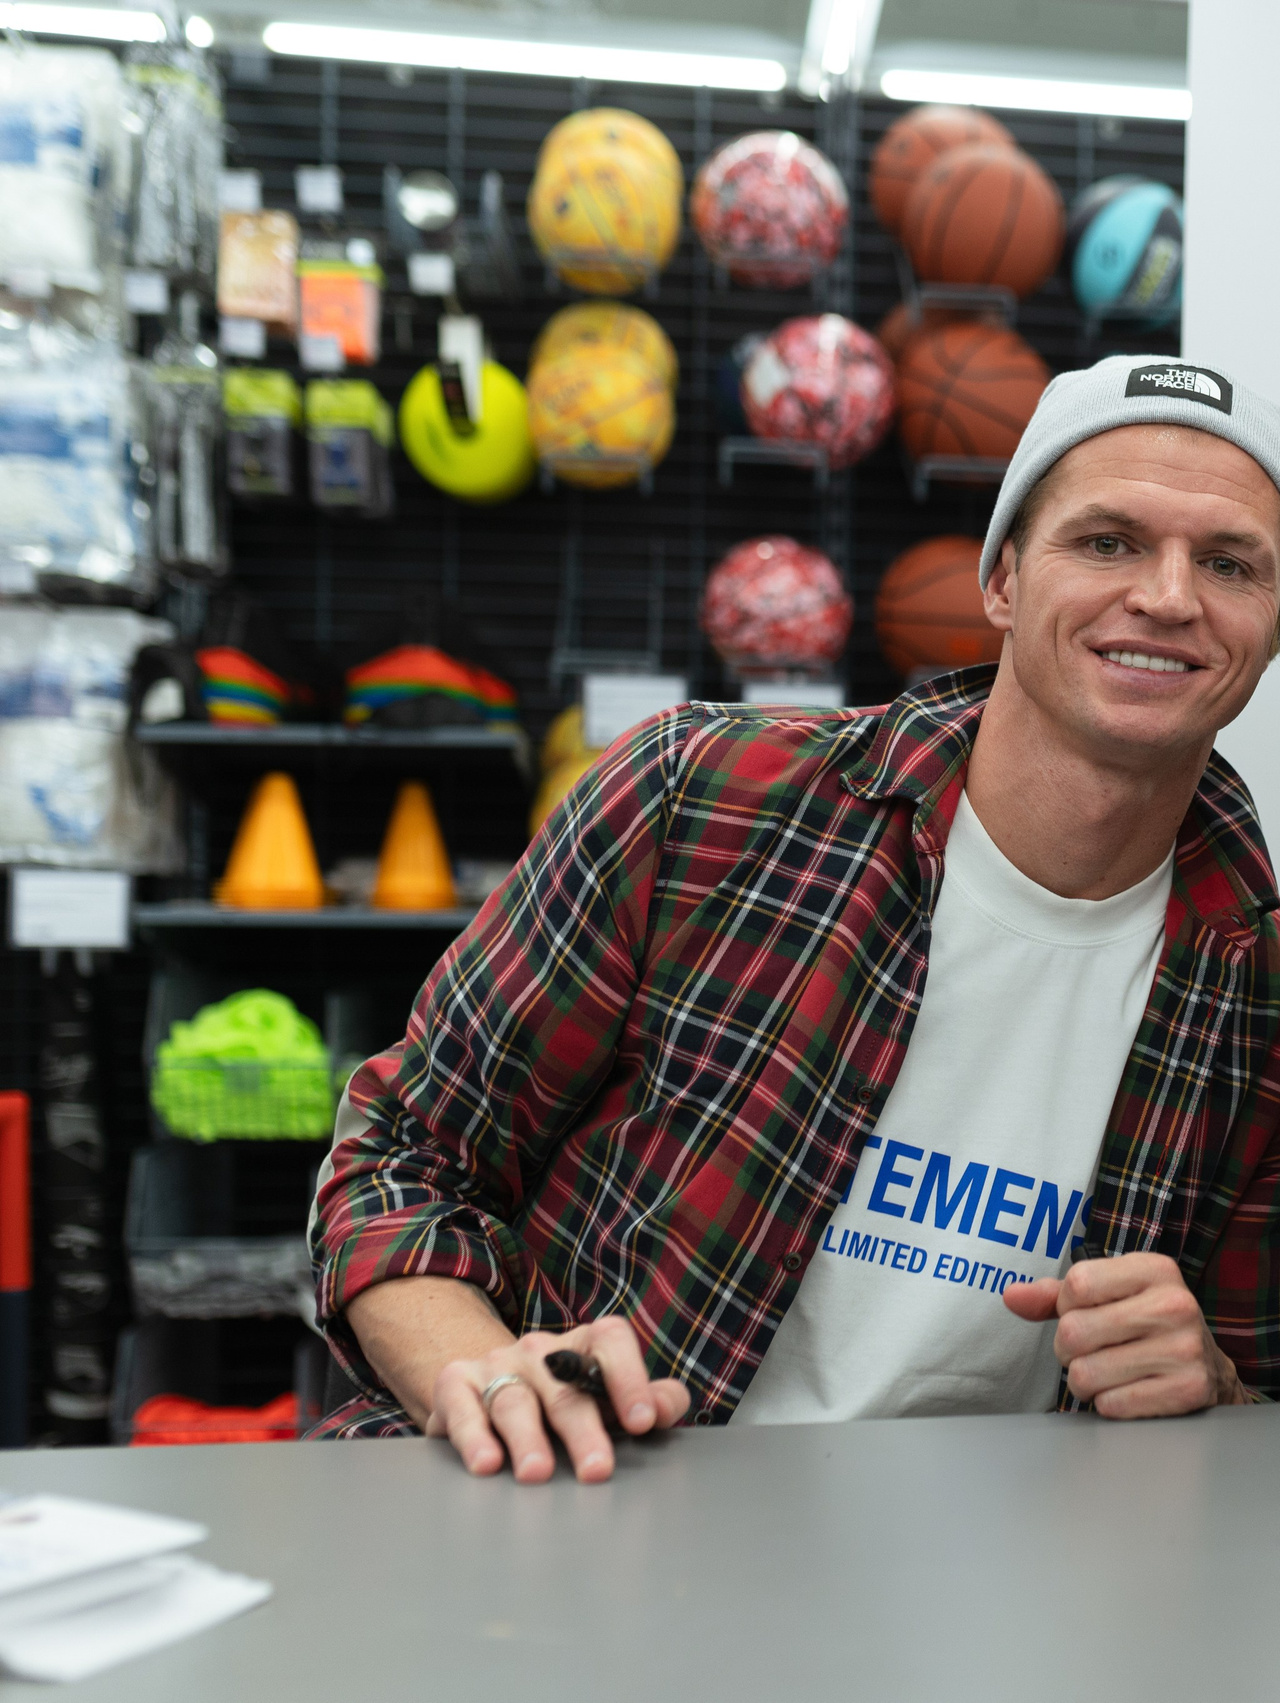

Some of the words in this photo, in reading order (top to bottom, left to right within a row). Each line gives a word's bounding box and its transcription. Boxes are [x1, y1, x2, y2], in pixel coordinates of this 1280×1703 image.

[1166, 368, 1196, 378] THE
[1140, 374, 1195, 386] NORTH
[1155, 380, 1194, 392] FACE
[821, 1224, 928, 1275] LIMITED
